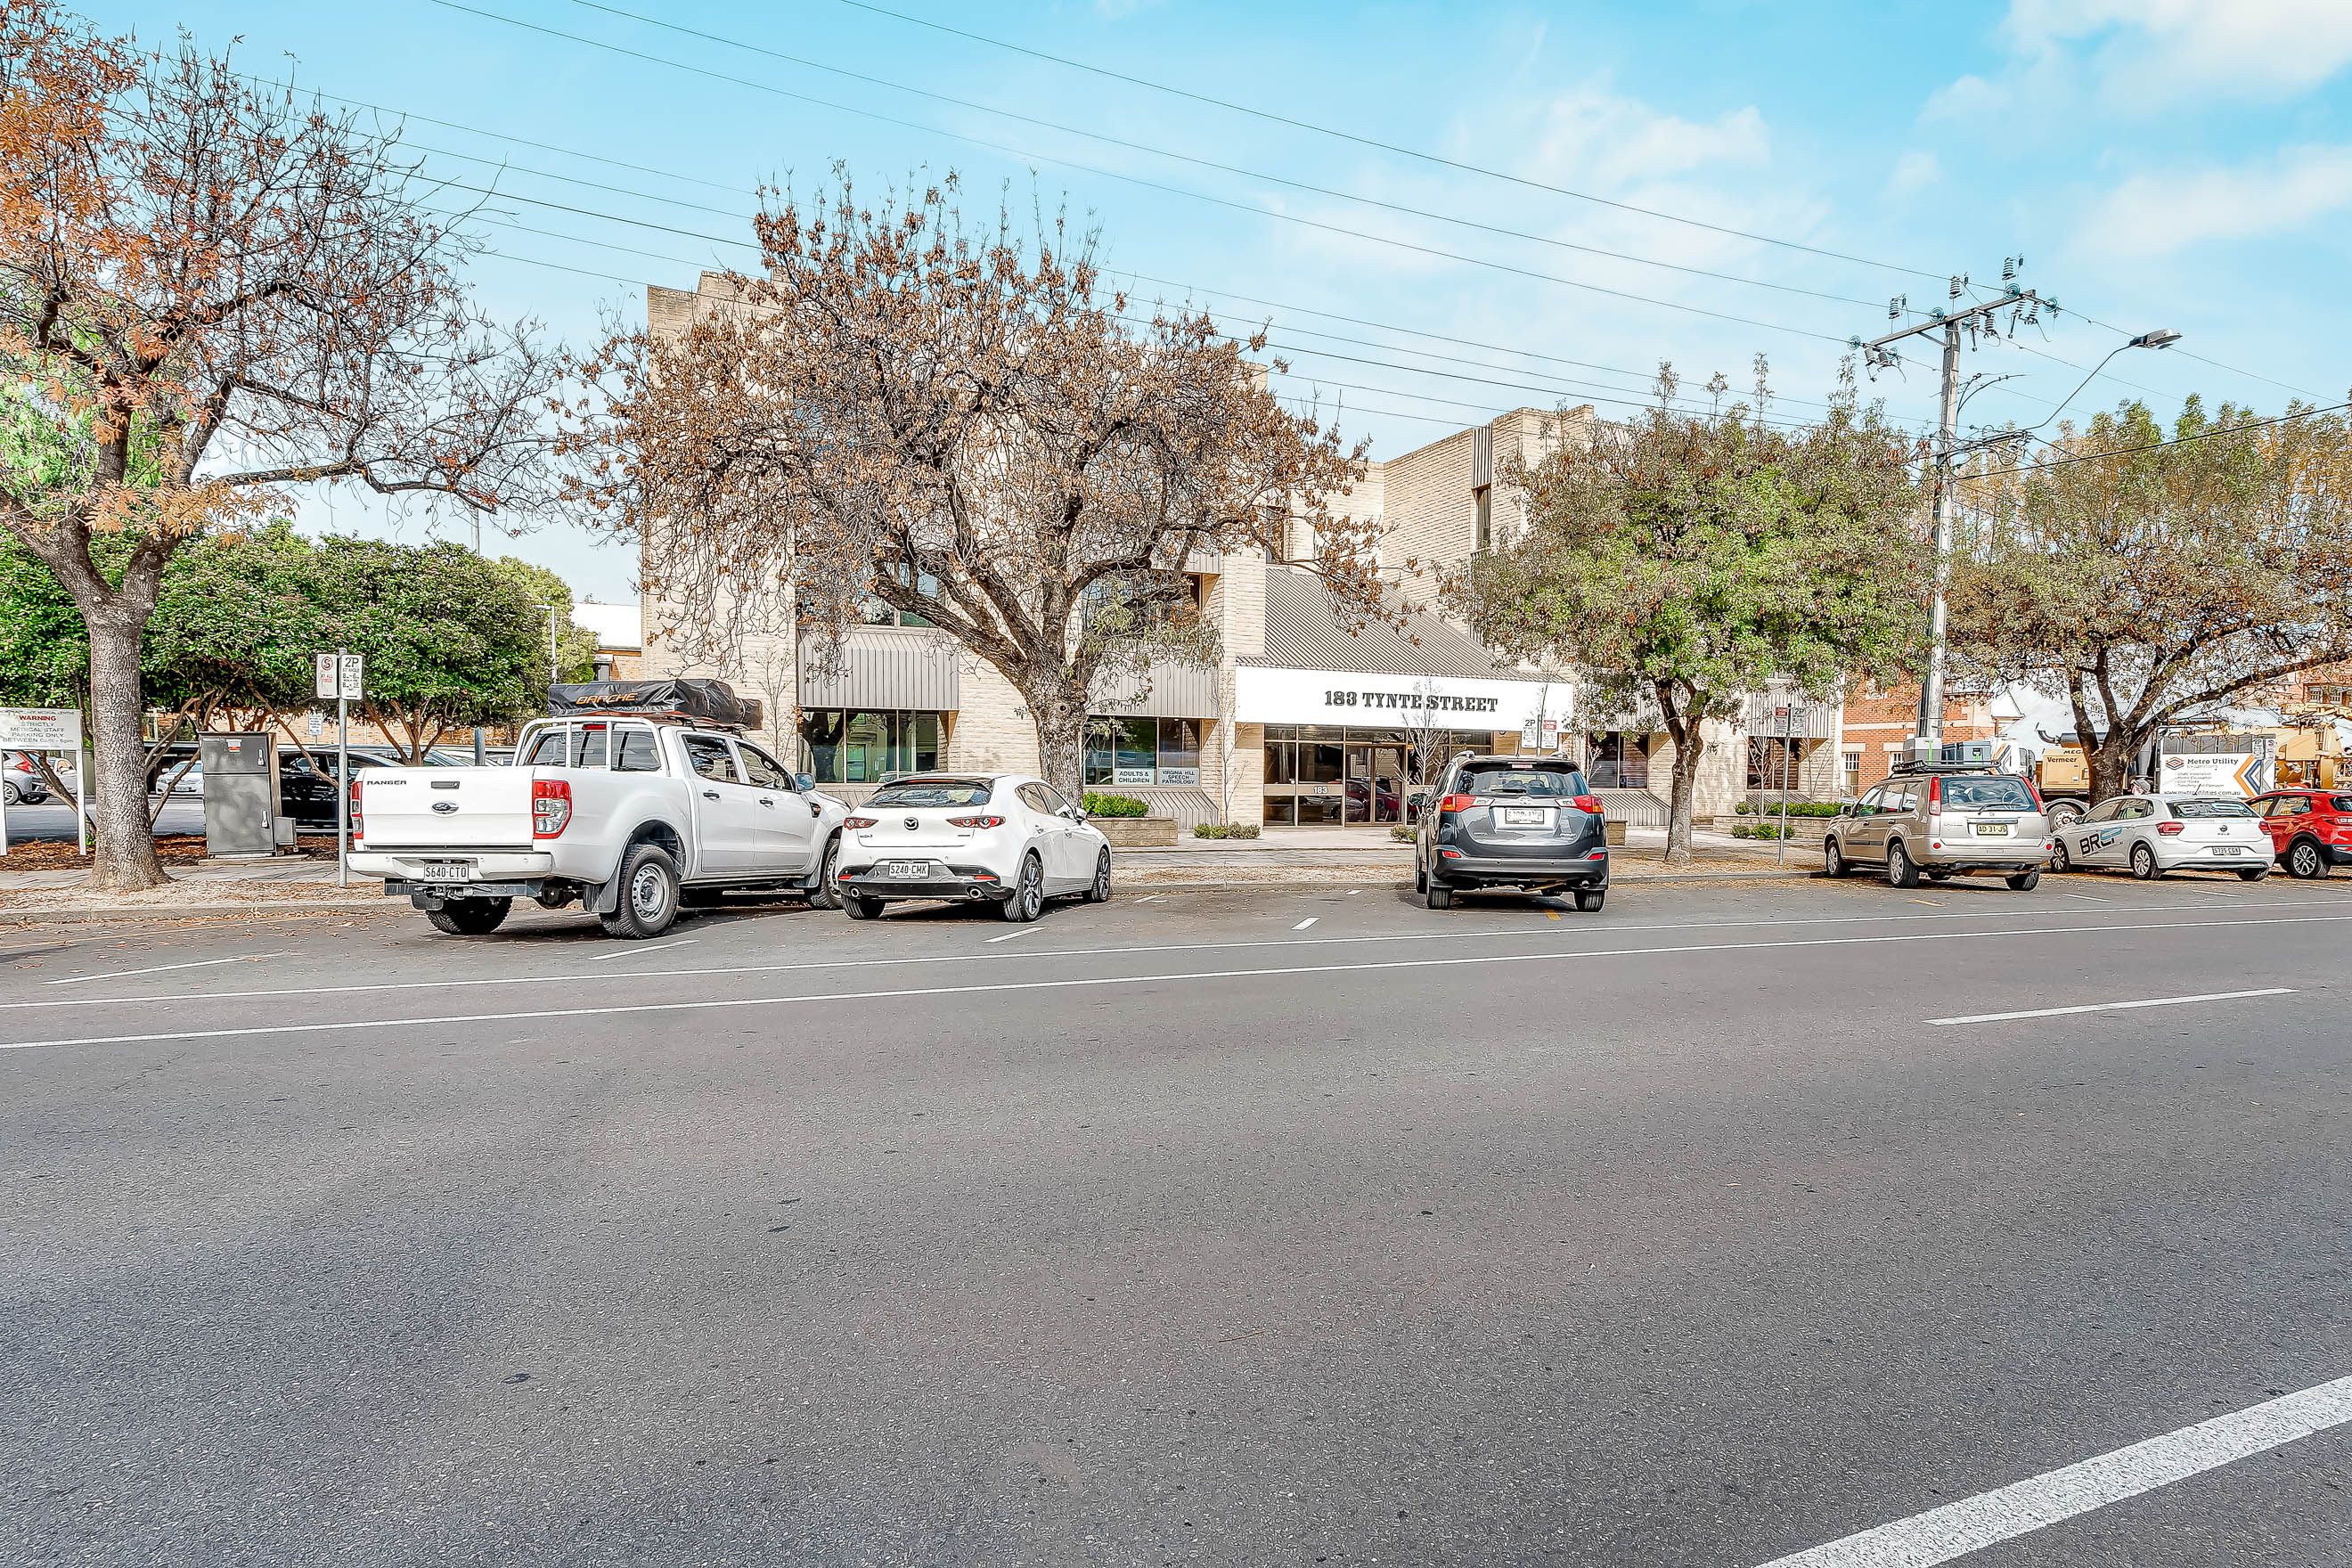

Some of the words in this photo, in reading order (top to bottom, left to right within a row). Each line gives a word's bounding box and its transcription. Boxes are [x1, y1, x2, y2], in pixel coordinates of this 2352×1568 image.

[345, 657, 359, 667] 2P
[576, 690, 639, 705] DARCHE
[1325, 690, 1357, 706] 183
[1362, 692, 1422, 709] TYNTE
[1425, 695, 1499, 713] STREET
[1524, 719, 1536, 727] 2P
[1313, 786, 1327, 794] 183
